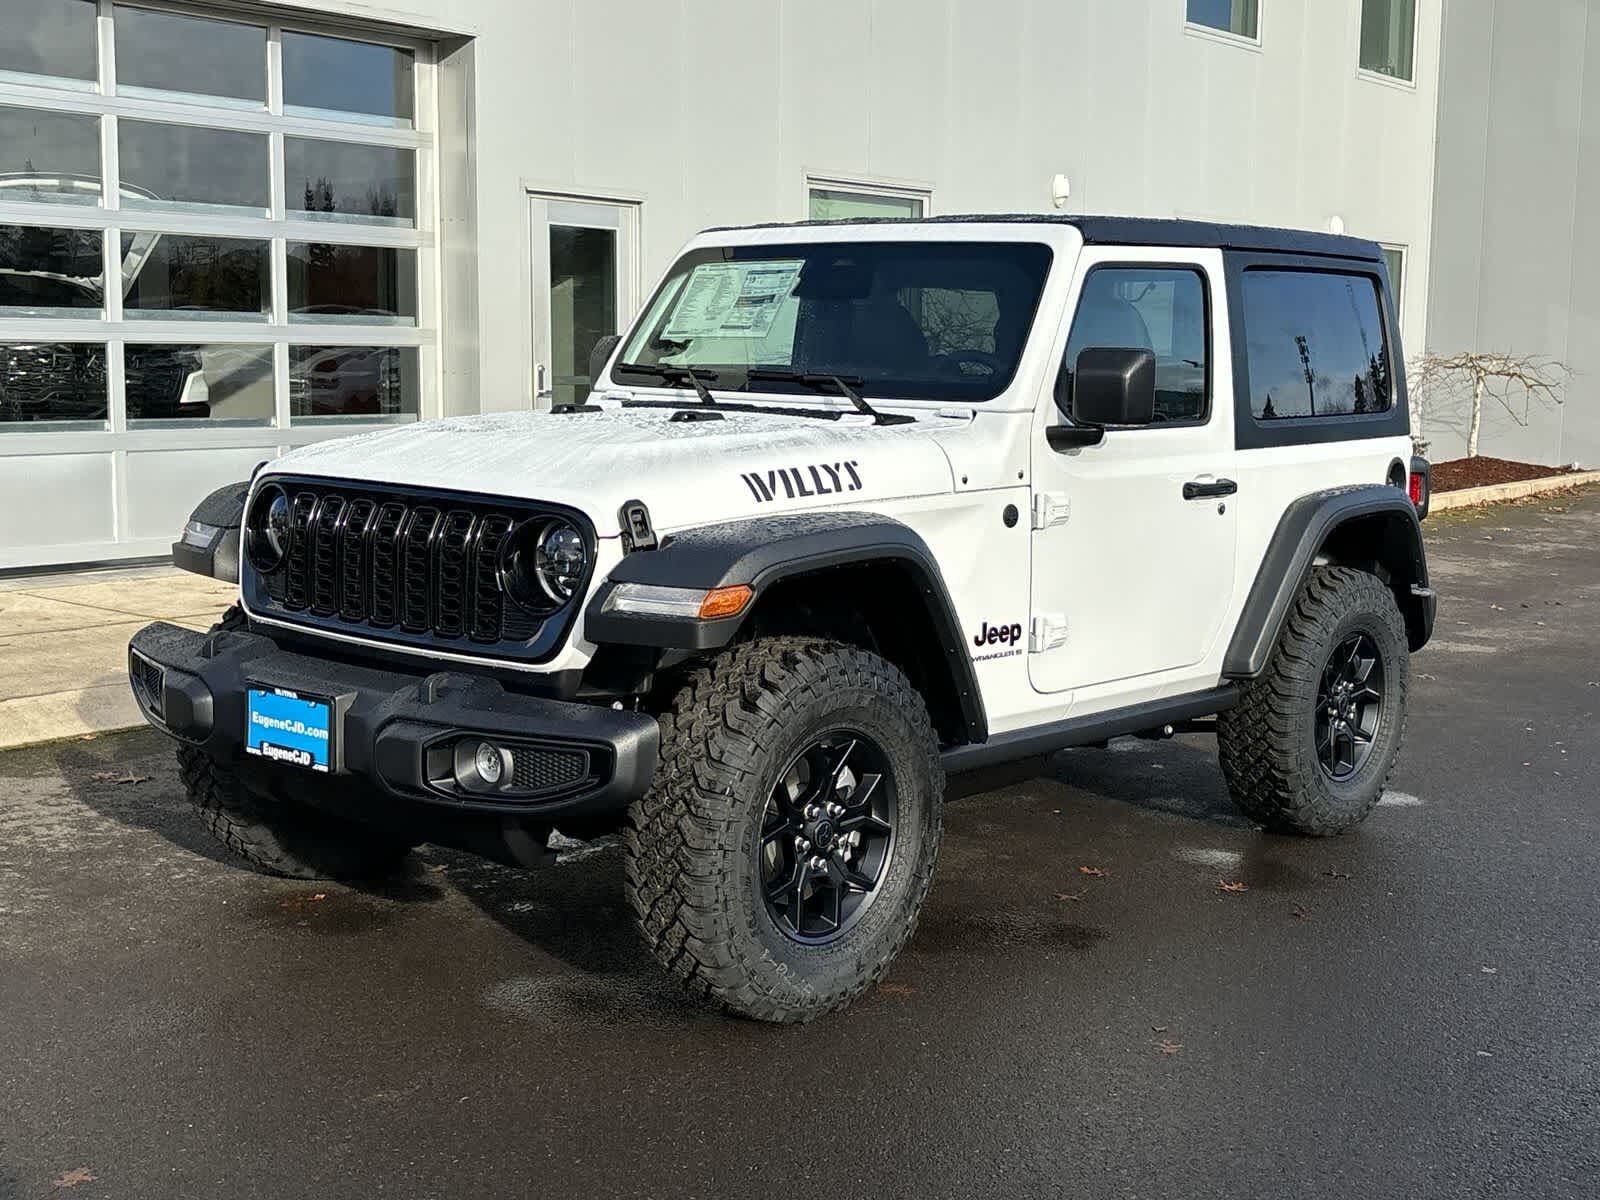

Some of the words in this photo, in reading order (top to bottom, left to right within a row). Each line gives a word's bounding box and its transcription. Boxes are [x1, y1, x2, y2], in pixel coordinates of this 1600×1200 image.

[740, 460, 862, 503] WILLYS
[974, 621, 1022, 647] Jeep
[252, 711, 329, 740] EugeneCJD.com
[262, 742, 311, 765] EugeneCJD
